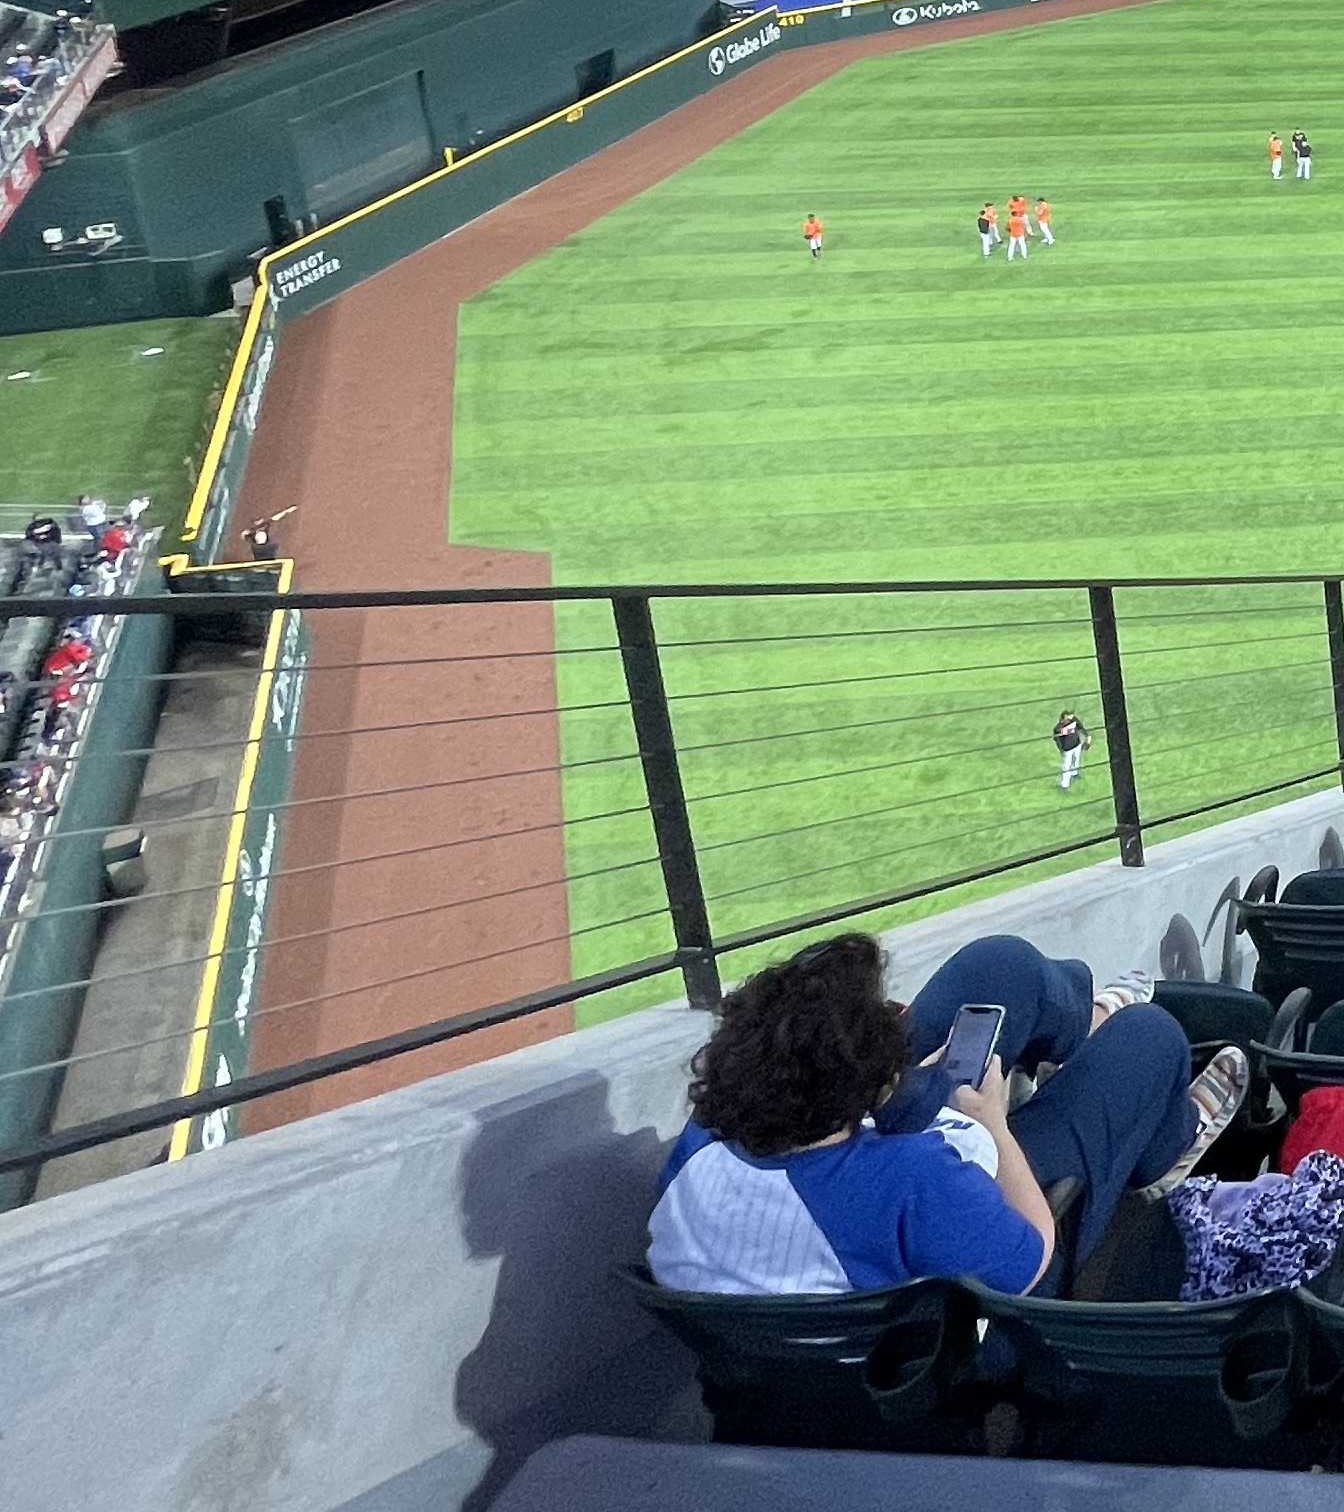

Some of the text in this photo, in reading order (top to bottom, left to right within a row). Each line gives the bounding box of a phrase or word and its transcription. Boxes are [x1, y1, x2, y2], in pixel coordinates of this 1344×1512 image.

[779, 14, 804, 27] 410
[725, 22, 782, 64] Globe Life
[276, 250, 325, 285] ENERGY
[280, 258, 341, 297] TRANSFER
